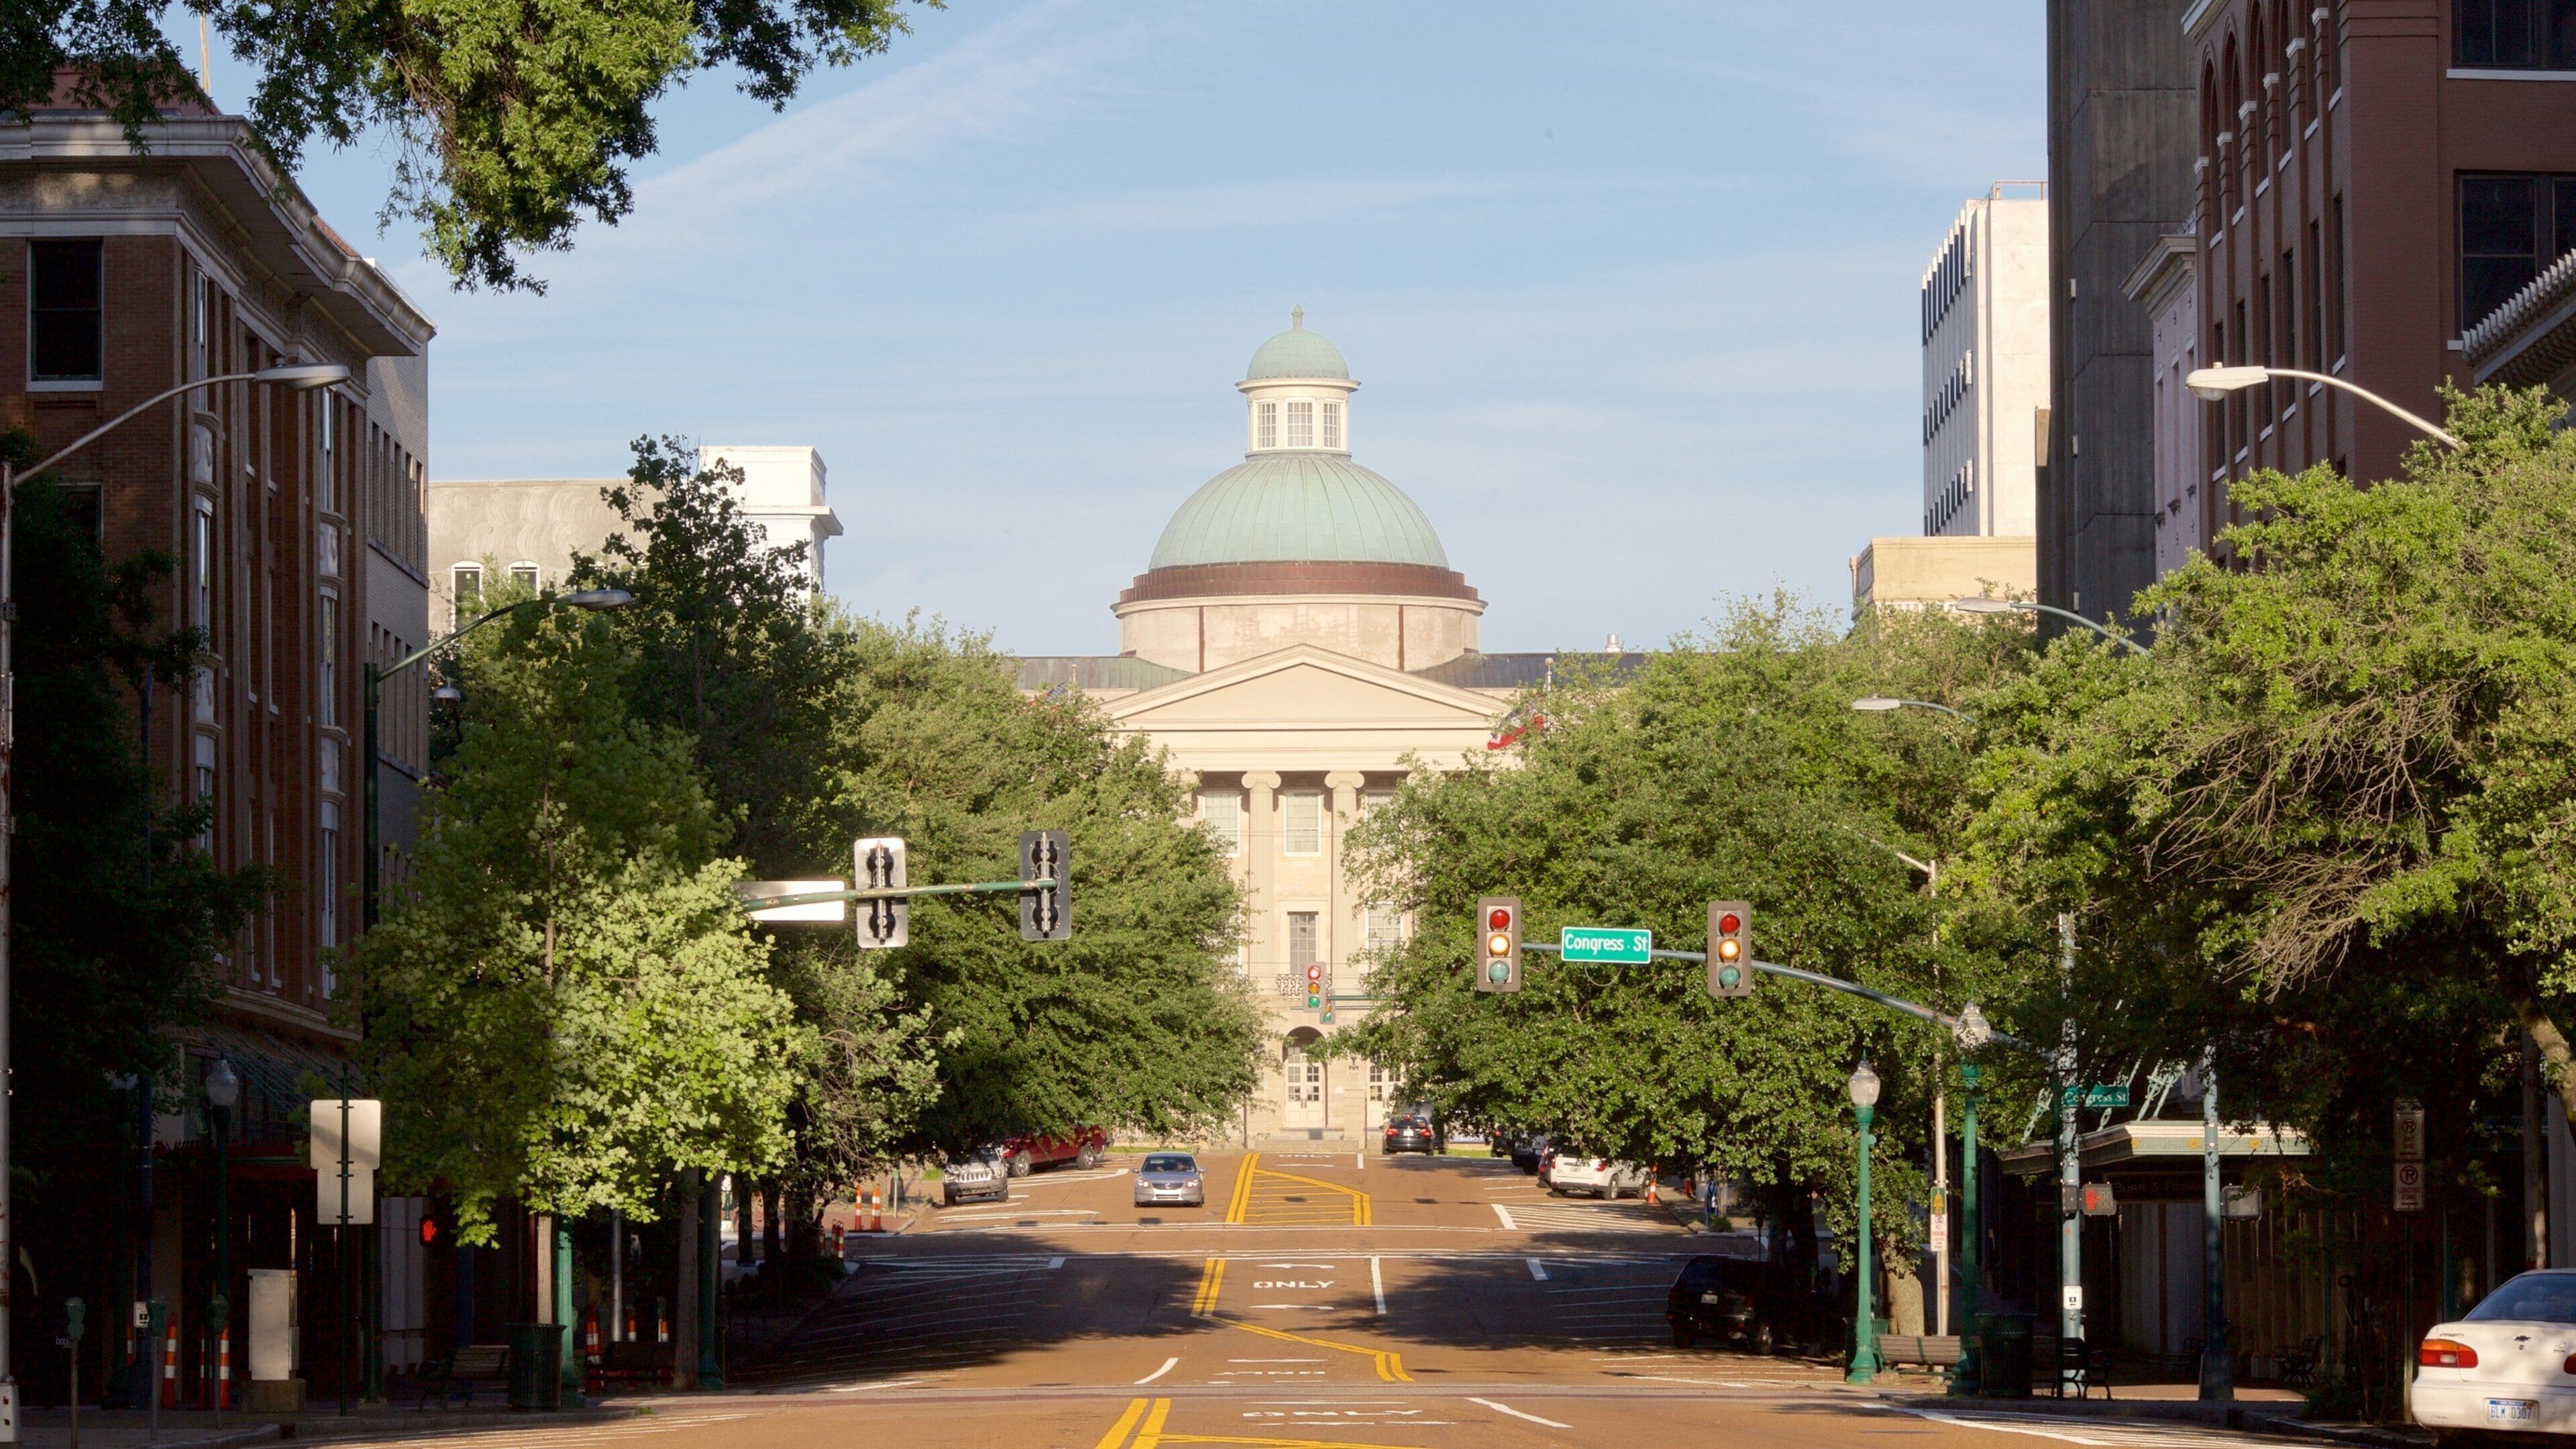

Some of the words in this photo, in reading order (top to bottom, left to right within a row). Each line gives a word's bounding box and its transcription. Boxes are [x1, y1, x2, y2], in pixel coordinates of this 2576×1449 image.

[1564, 933, 1625, 955] Congress
[1633, 936, 1648, 953] St
[2115, 1091, 2127, 1102] St
[1253, 1280, 1335, 1289] ONLY
[1242, 1409, 1424, 1417] ONLY
